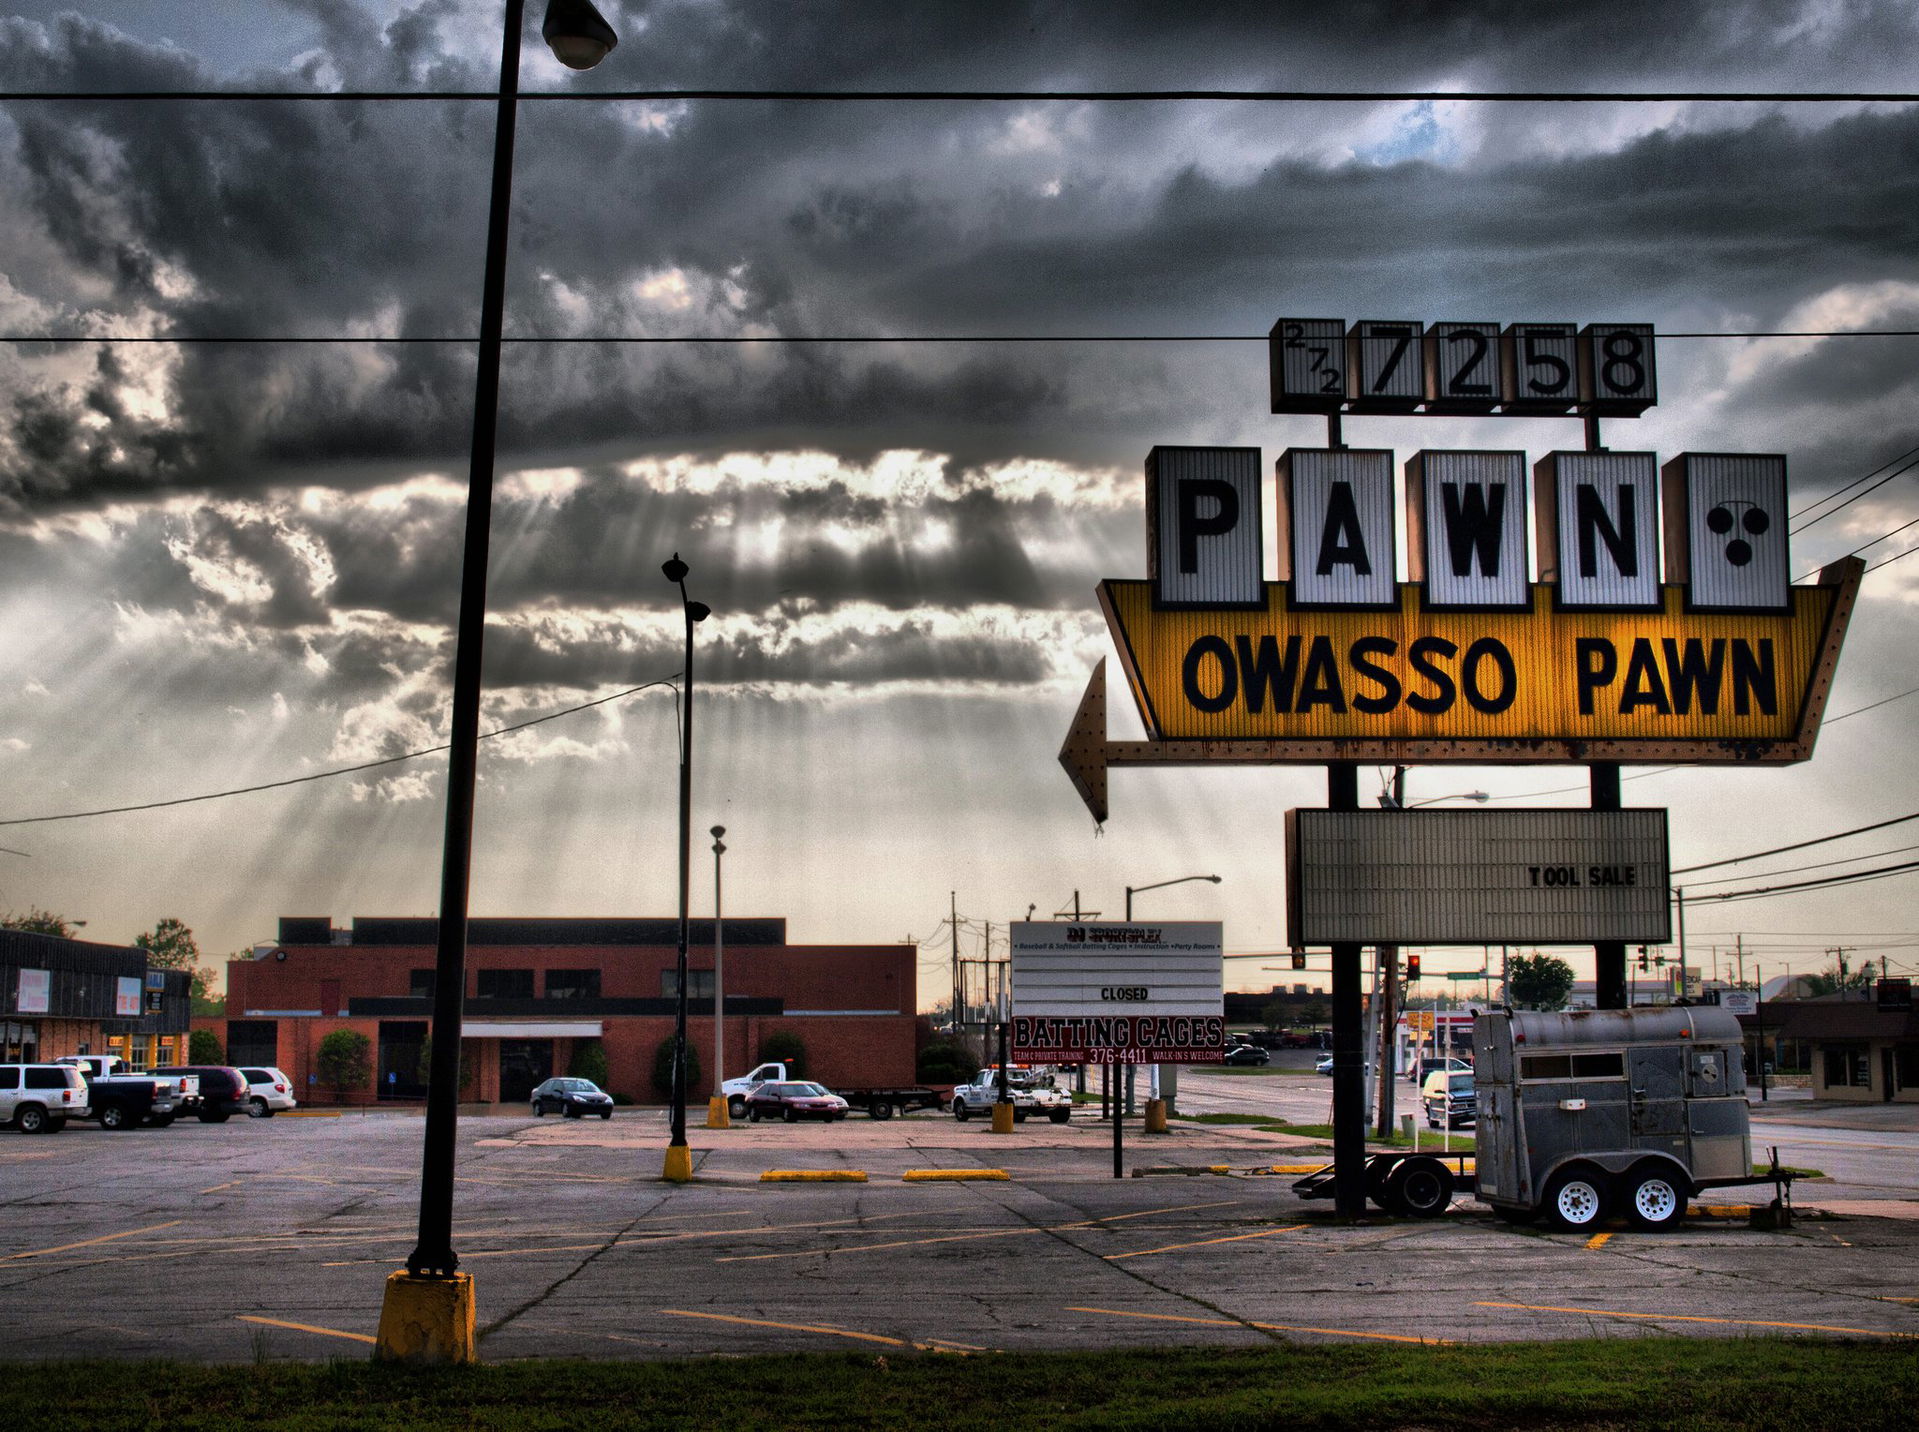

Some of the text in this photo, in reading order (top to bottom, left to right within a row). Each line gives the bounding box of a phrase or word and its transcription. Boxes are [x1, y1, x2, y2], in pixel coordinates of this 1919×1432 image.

[1177, 478, 1638, 578] PAWN
[1182, 634, 1778, 716] OWASSO PAWN
[1527, 866, 1636, 887] TOOL SALE
[1082, 943, 1106, 951] Batting
[1101, 987, 1149, 1001] CLOSED
[1013, 1017, 1224, 1048] BATTING CAGES
[1013, 1051, 1030, 1061] TEAM
[1034, 1051, 1057, 1061] PRIVATE
[1059, 1051, 1084, 1061] TRAINING
[1090, 1048, 1147, 1064] 376-4411
[1190, 1050, 1224, 1061] WELCOME
